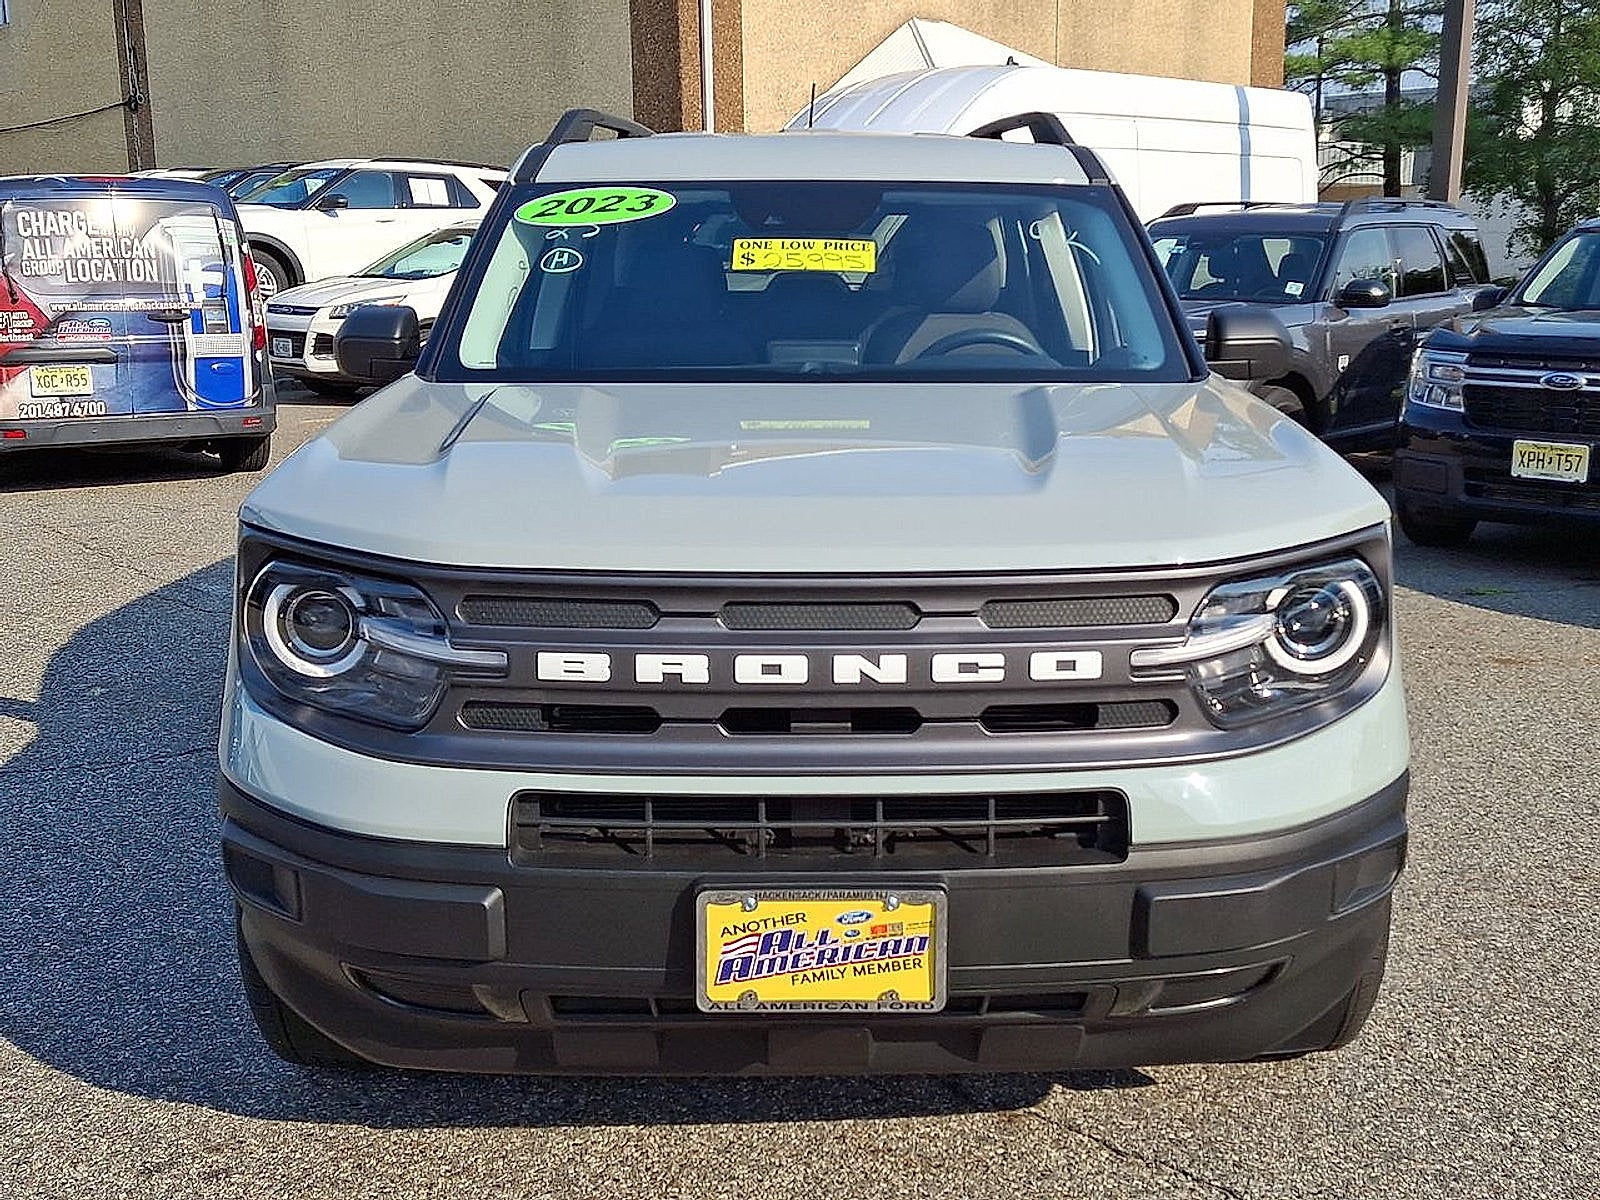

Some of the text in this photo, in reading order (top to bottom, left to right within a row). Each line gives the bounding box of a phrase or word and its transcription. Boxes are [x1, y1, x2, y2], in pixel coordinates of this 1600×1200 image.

[530, 194, 660, 219] 2023
[17, 210, 98, 237] CHARGE
[23, 237, 156, 260] ALL AMERICAN
[740, 241, 871, 252] ONE LOW PRICE
[20, 259, 159, 283] GROUP LOCATION
[740, 251, 756, 267] $
[18, 400, 107, 419] 201.487.6700
[536, 651, 1103, 684] BRONCO
[720, 912, 808, 938] ANOTHER
[839, 911, 870, 924] Ford
[759, 928, 840, 955] ALL
[716, 936, 930, 984] AMERICAN
[791, 957, 924, 987] FAMILY MEMBER
[709, 1001, 934, 1010] ALL AMERICAN FORD
